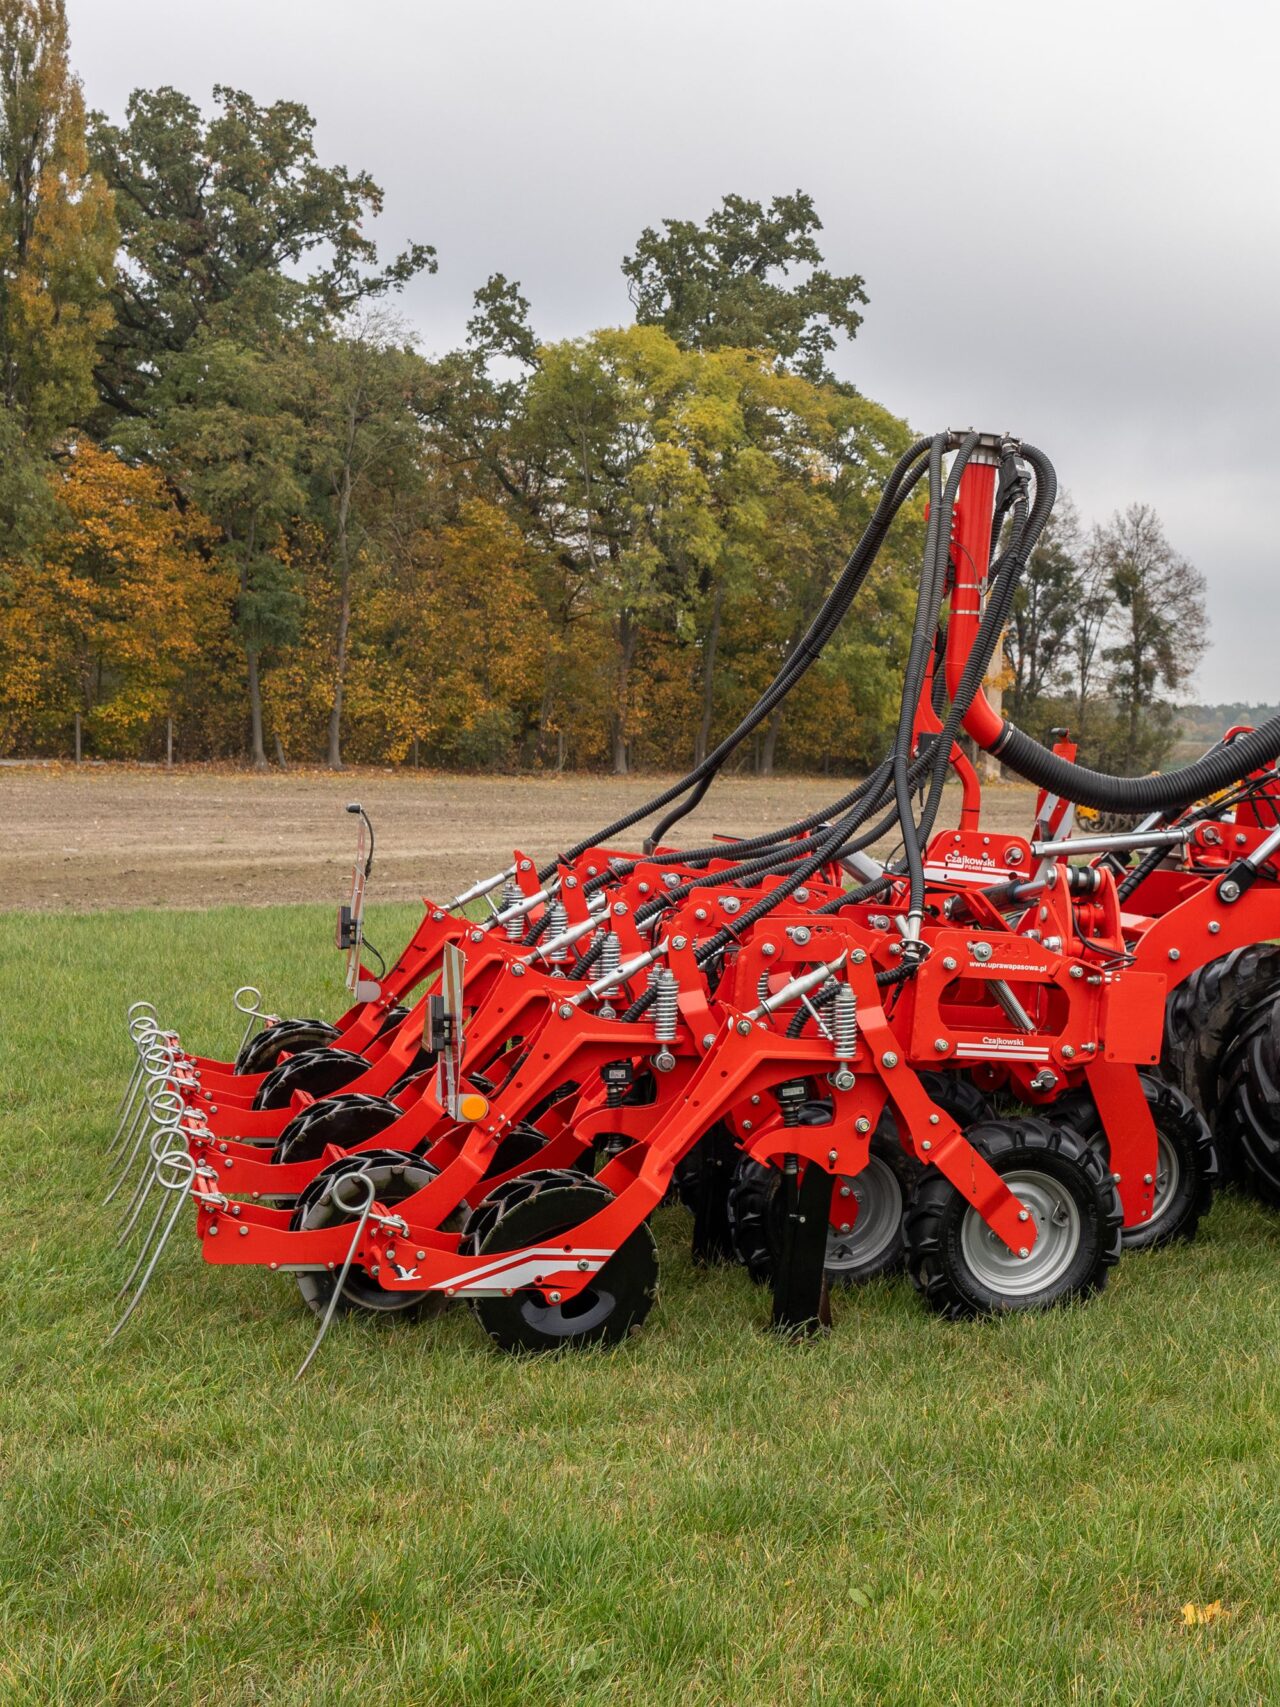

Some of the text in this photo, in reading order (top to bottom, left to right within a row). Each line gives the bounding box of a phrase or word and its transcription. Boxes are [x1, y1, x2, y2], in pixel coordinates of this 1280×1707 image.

[945, 853, 996, 868] Czajkowski
[969, 961, 1048, 974] www.uprawapasowa.pl
[982, 1036, 1025, 1048] Czajkowski
